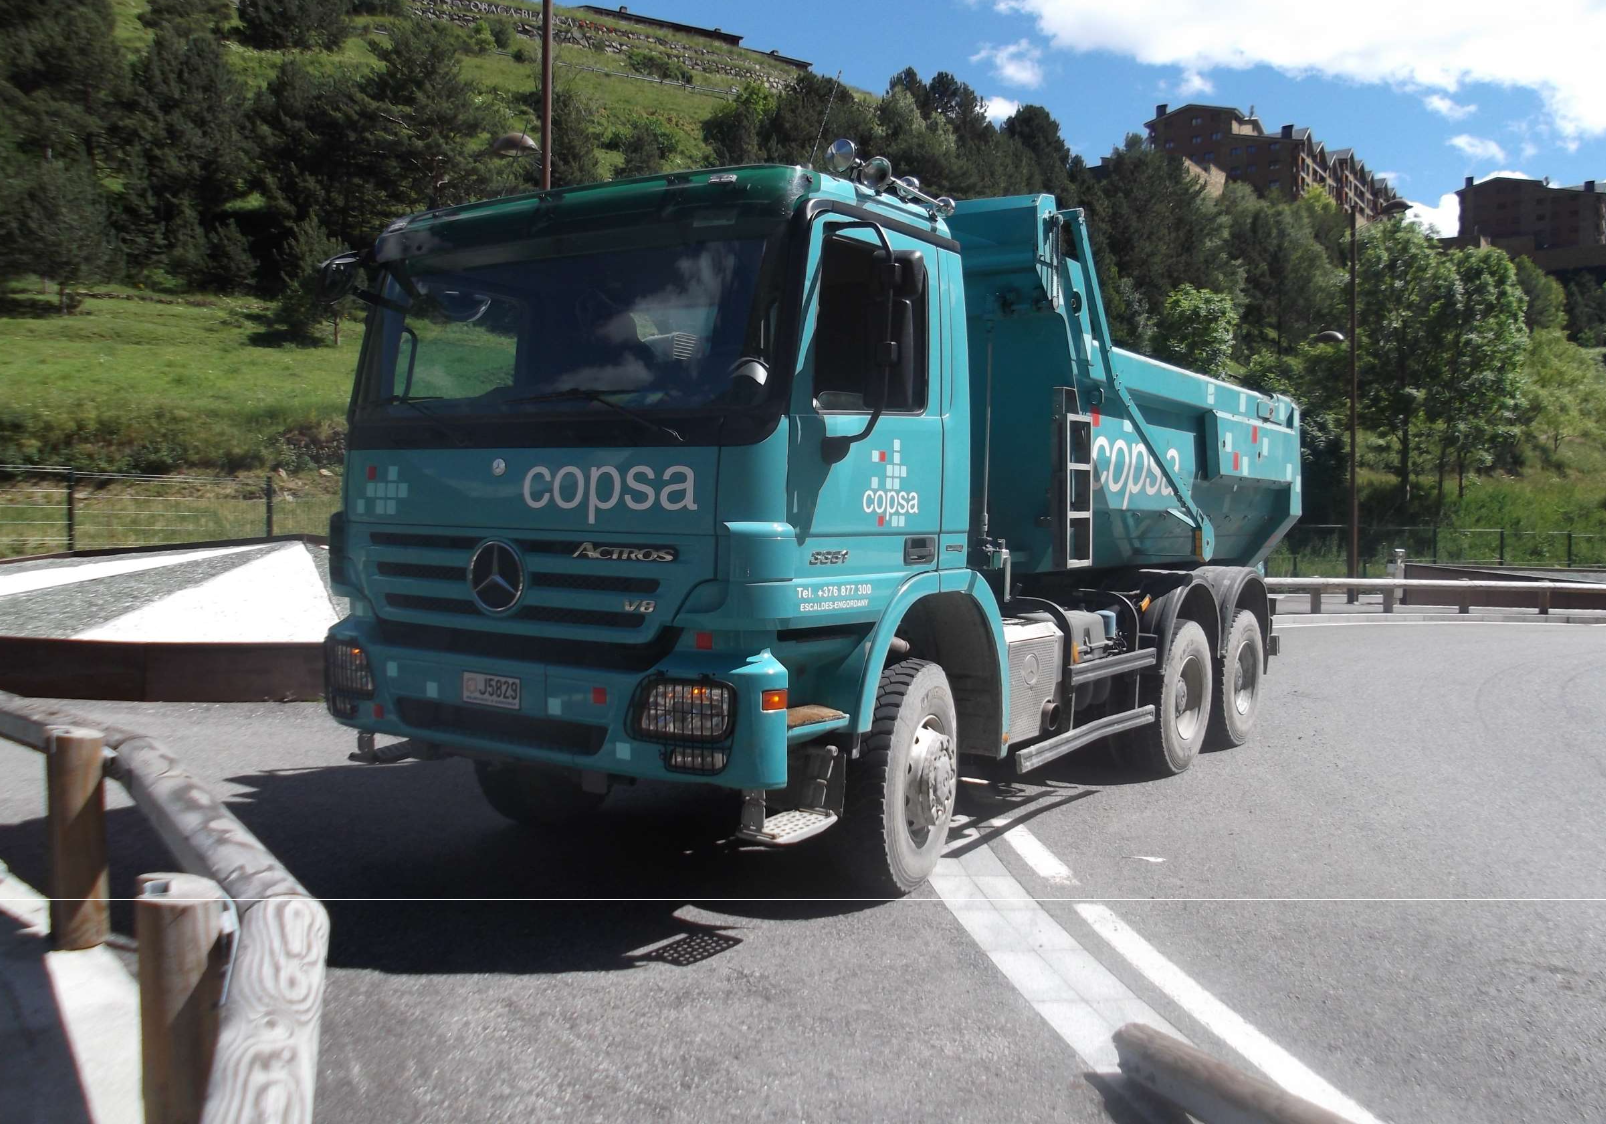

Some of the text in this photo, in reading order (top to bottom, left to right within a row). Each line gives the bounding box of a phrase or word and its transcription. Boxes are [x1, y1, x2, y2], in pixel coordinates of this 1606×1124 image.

[523, 465, 698, 525] copsa
[862, 490, 919, 521] copsa
[797, 584, 871, 598] Tel. +376 877 300
[623, 600, 656, 613] V8
[478, 677, 519, 701] J5829
